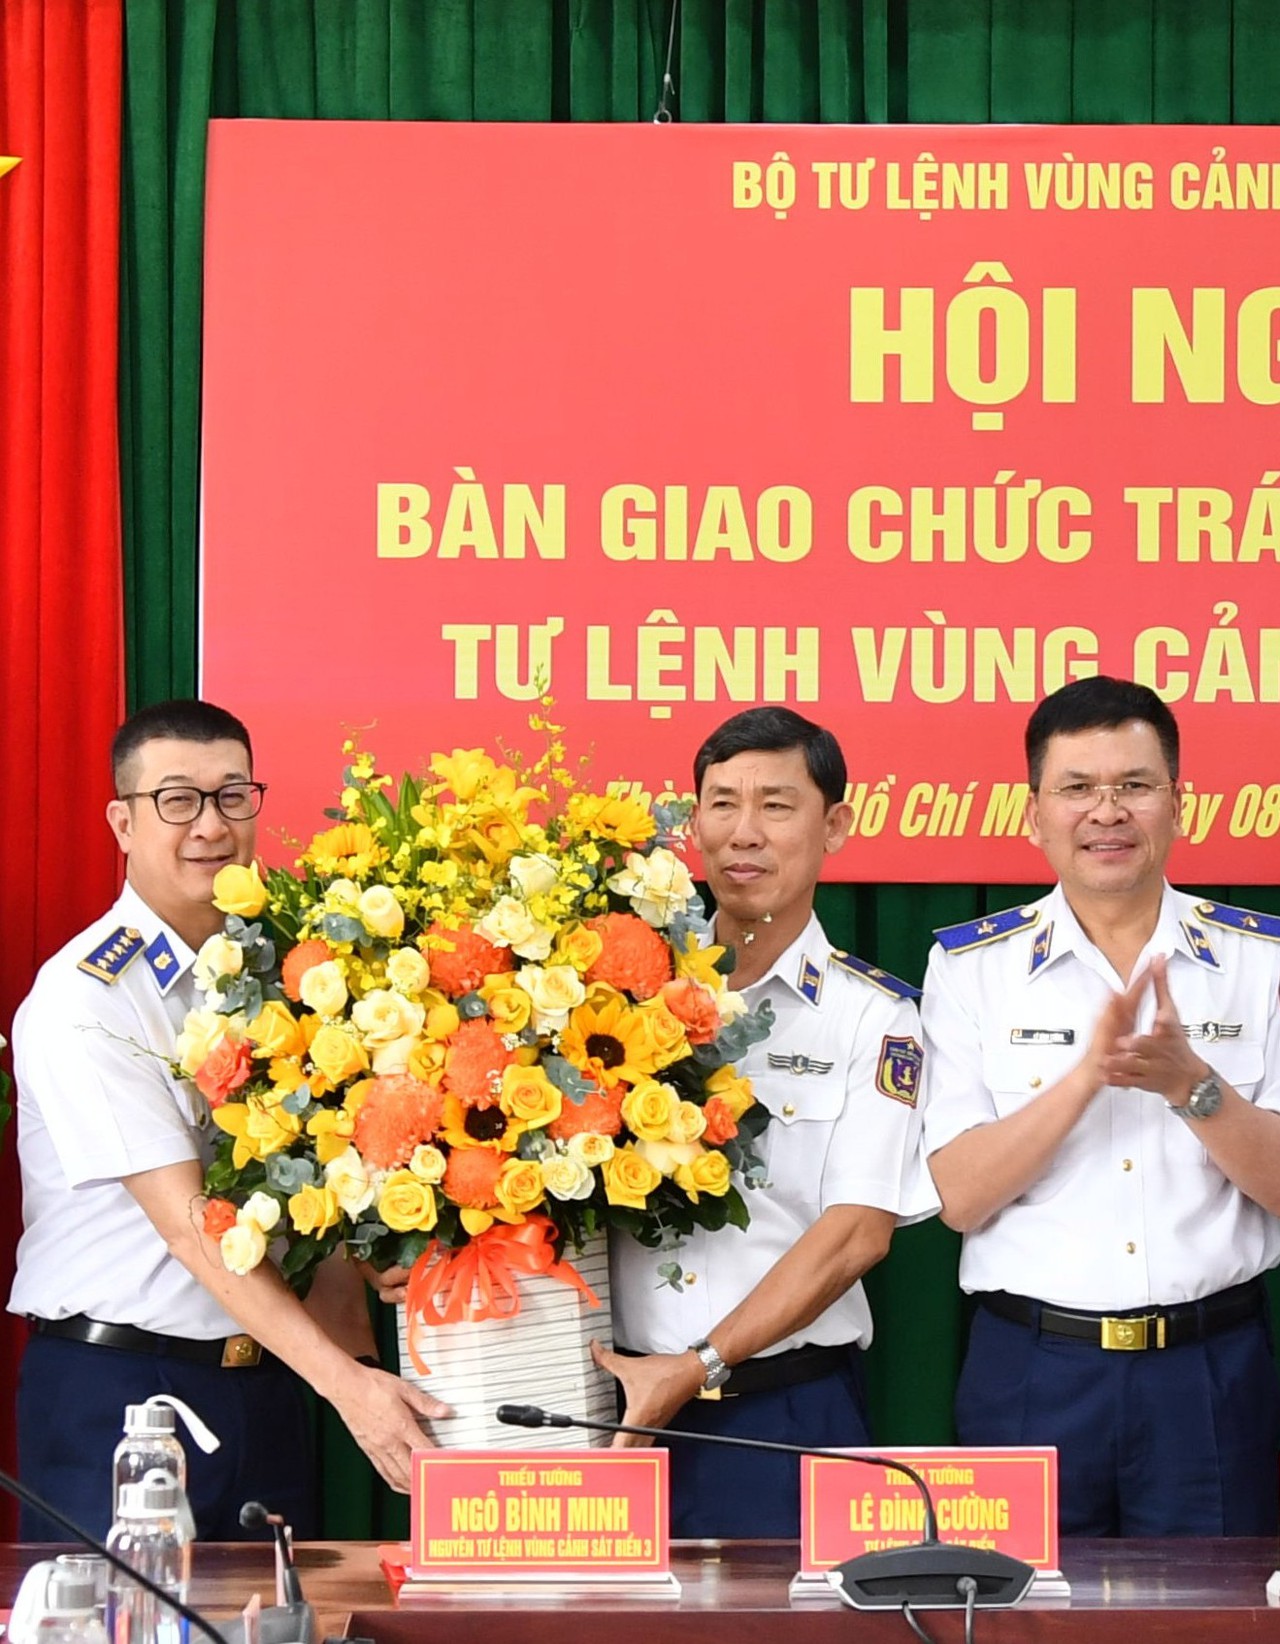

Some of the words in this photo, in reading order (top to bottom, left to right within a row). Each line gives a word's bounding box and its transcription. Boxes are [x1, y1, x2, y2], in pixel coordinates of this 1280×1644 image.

[732, 151, 796, 220] BỘ
[811, 157, 876, 210] TƯ
[886, 152, 1009, 221] LỆNH
[1023, 152, 1154, 210] VÙNG
[850, 261, 1077, 431] HỘI
[376, 466, 566, 560] BÀN
[600, 483, 813, 563] GIAO
[847, 470, 1092, 564] CHỨC
[441, 616, 565, 701] TƯ
[586, 609, 820, 719] LỆNH
[851, 610, 1099, 704] VÙNG
[843, 774, 896, 837] Hồ
[899, 781, 979, 838] Chí
[1180, 781, 1224, 845] ày
[451, 1490, 499, 1532] NGÔ
[505, 1490, 561, 1532] BÌNH
[567, 1497, 629, 1532] MINH
[498, 1466, 536, 1486] THIẾU
[849, 1492, 874, 1532] LÊ
[936, 1491, 1009, 1532] CƯỜNG
[643, 1539, 652, 1558] 3
